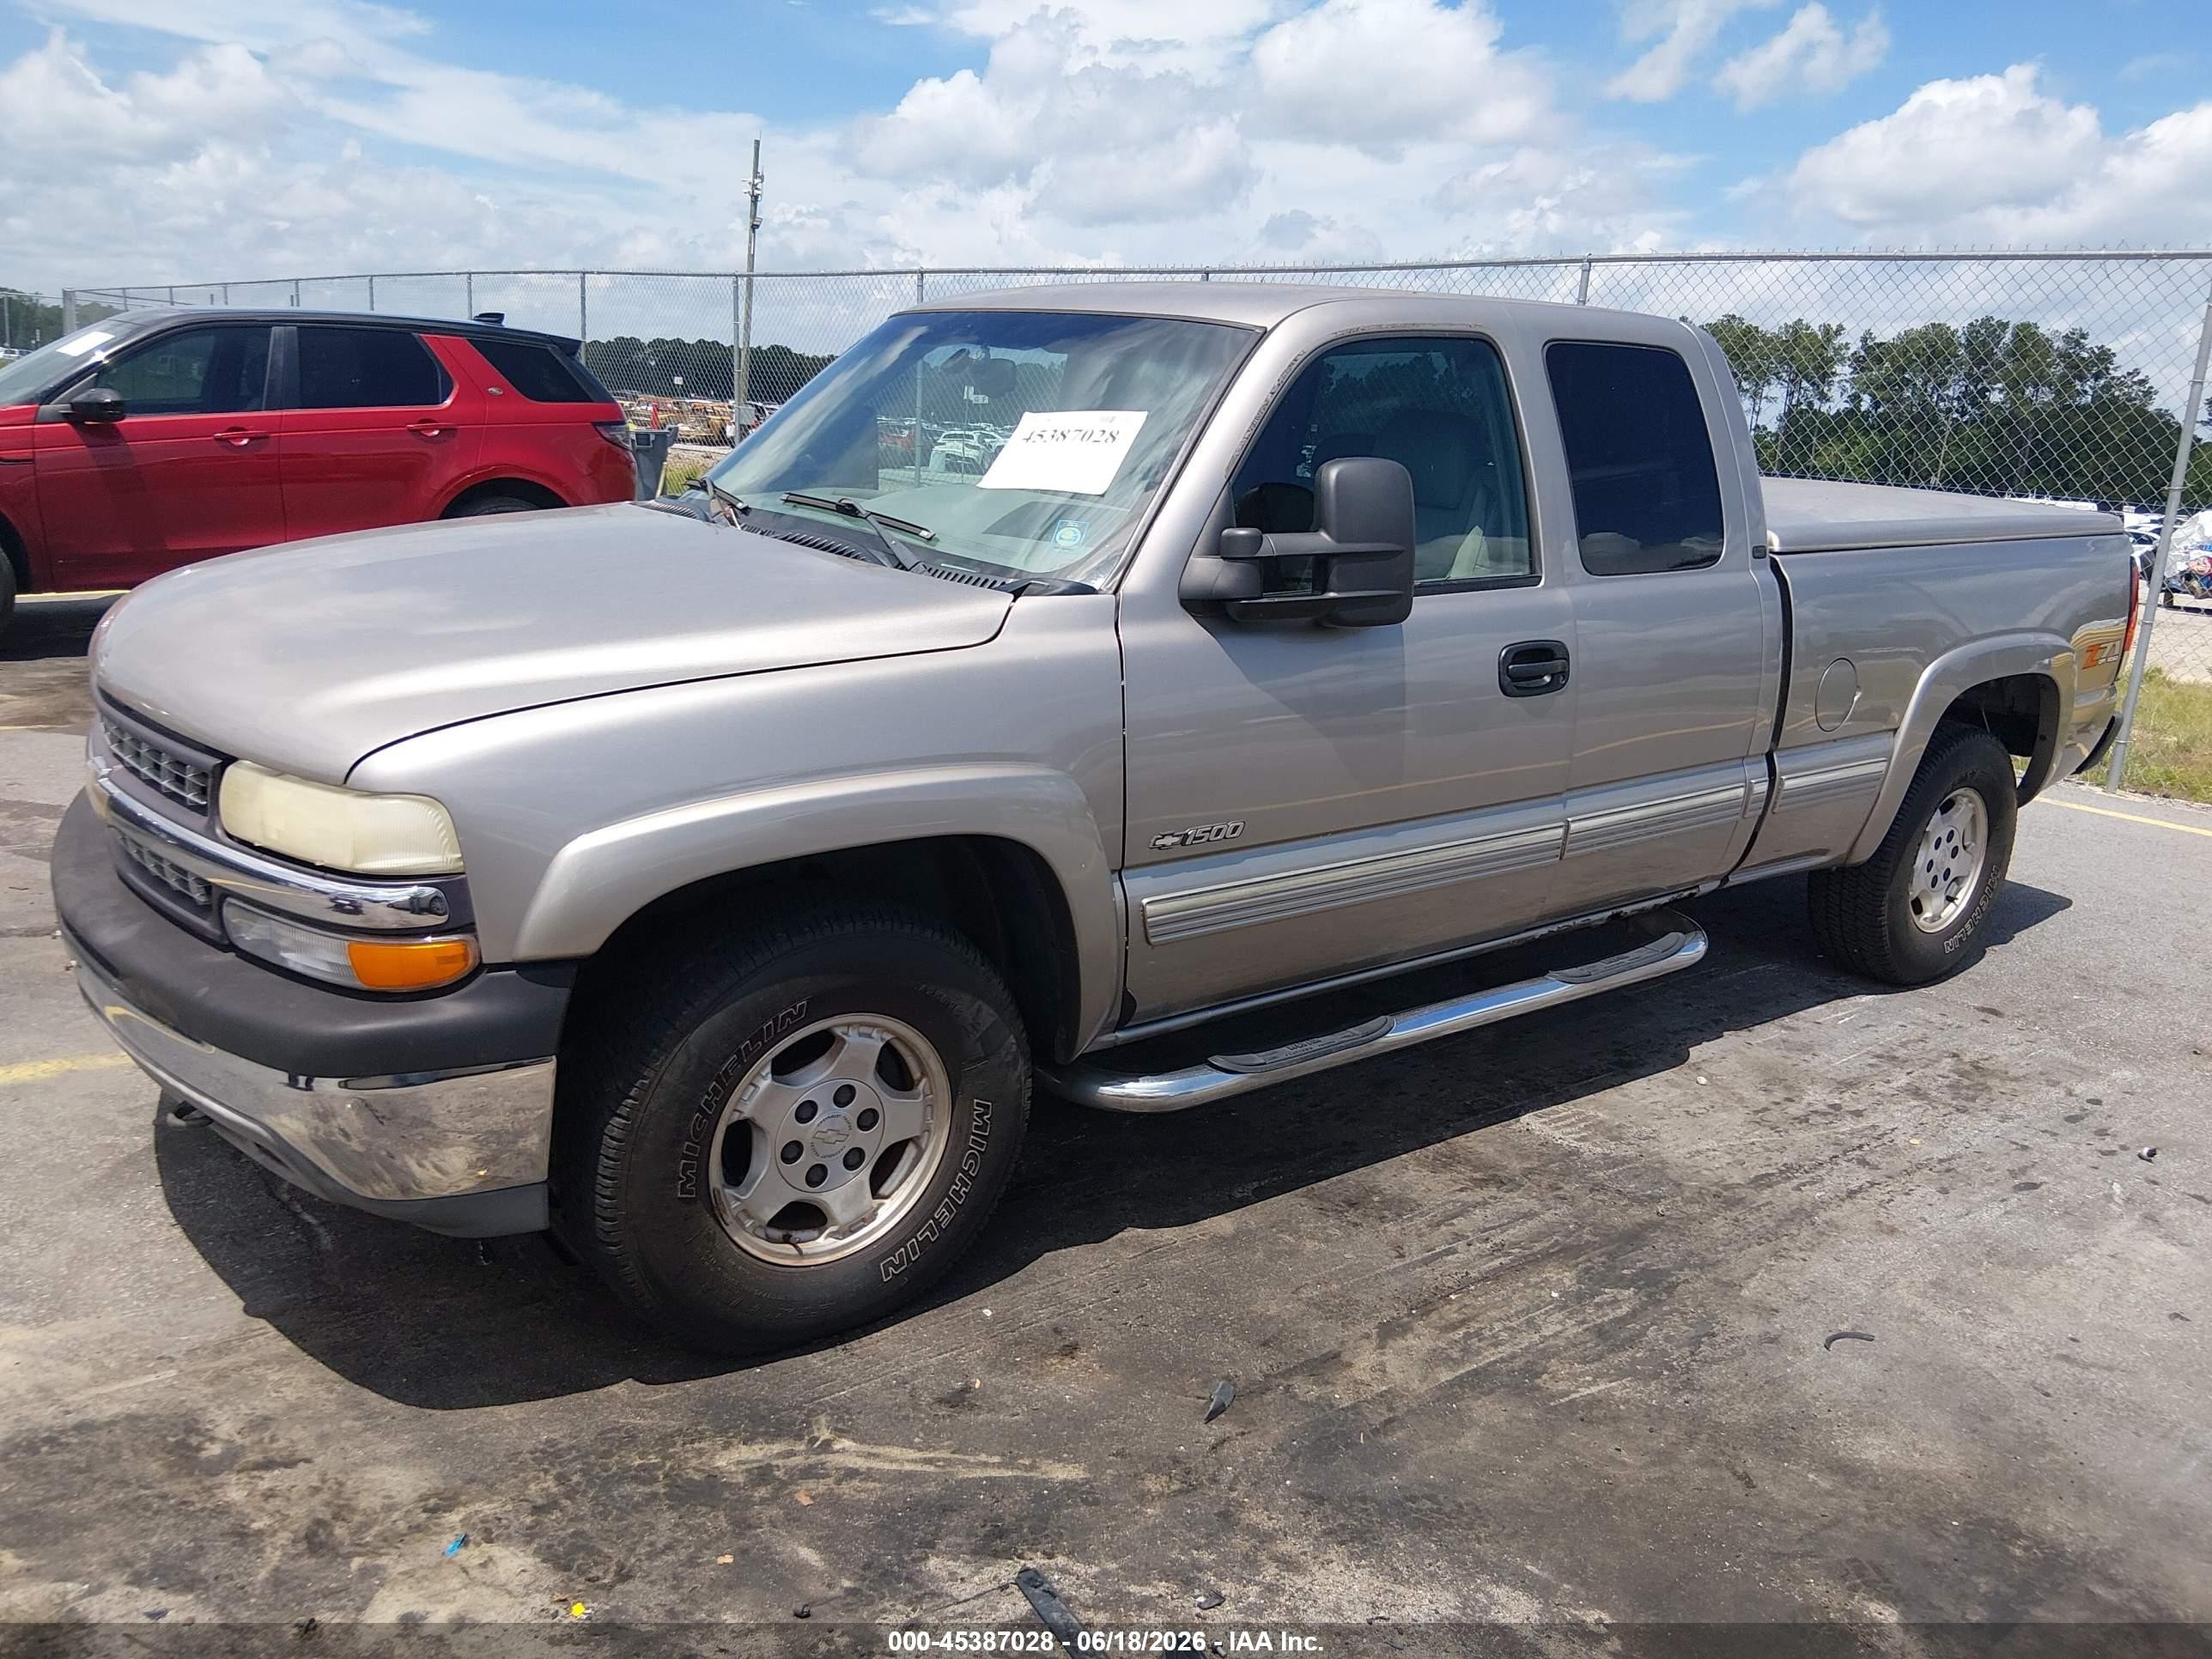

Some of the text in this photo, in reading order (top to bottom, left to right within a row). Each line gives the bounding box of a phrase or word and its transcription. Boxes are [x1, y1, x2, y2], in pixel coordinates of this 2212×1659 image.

[1022, 428, 1120, 444] 45387028
[2082, 640, 2120, 669] Z71
[1183, 821, 1246, 845] 1500
[1943, 865, 2000, 953] MICHELIN
[678, 1000, 810, 1198] MICHELIN
[881, 1099, 993, 1282] MICHELIN
